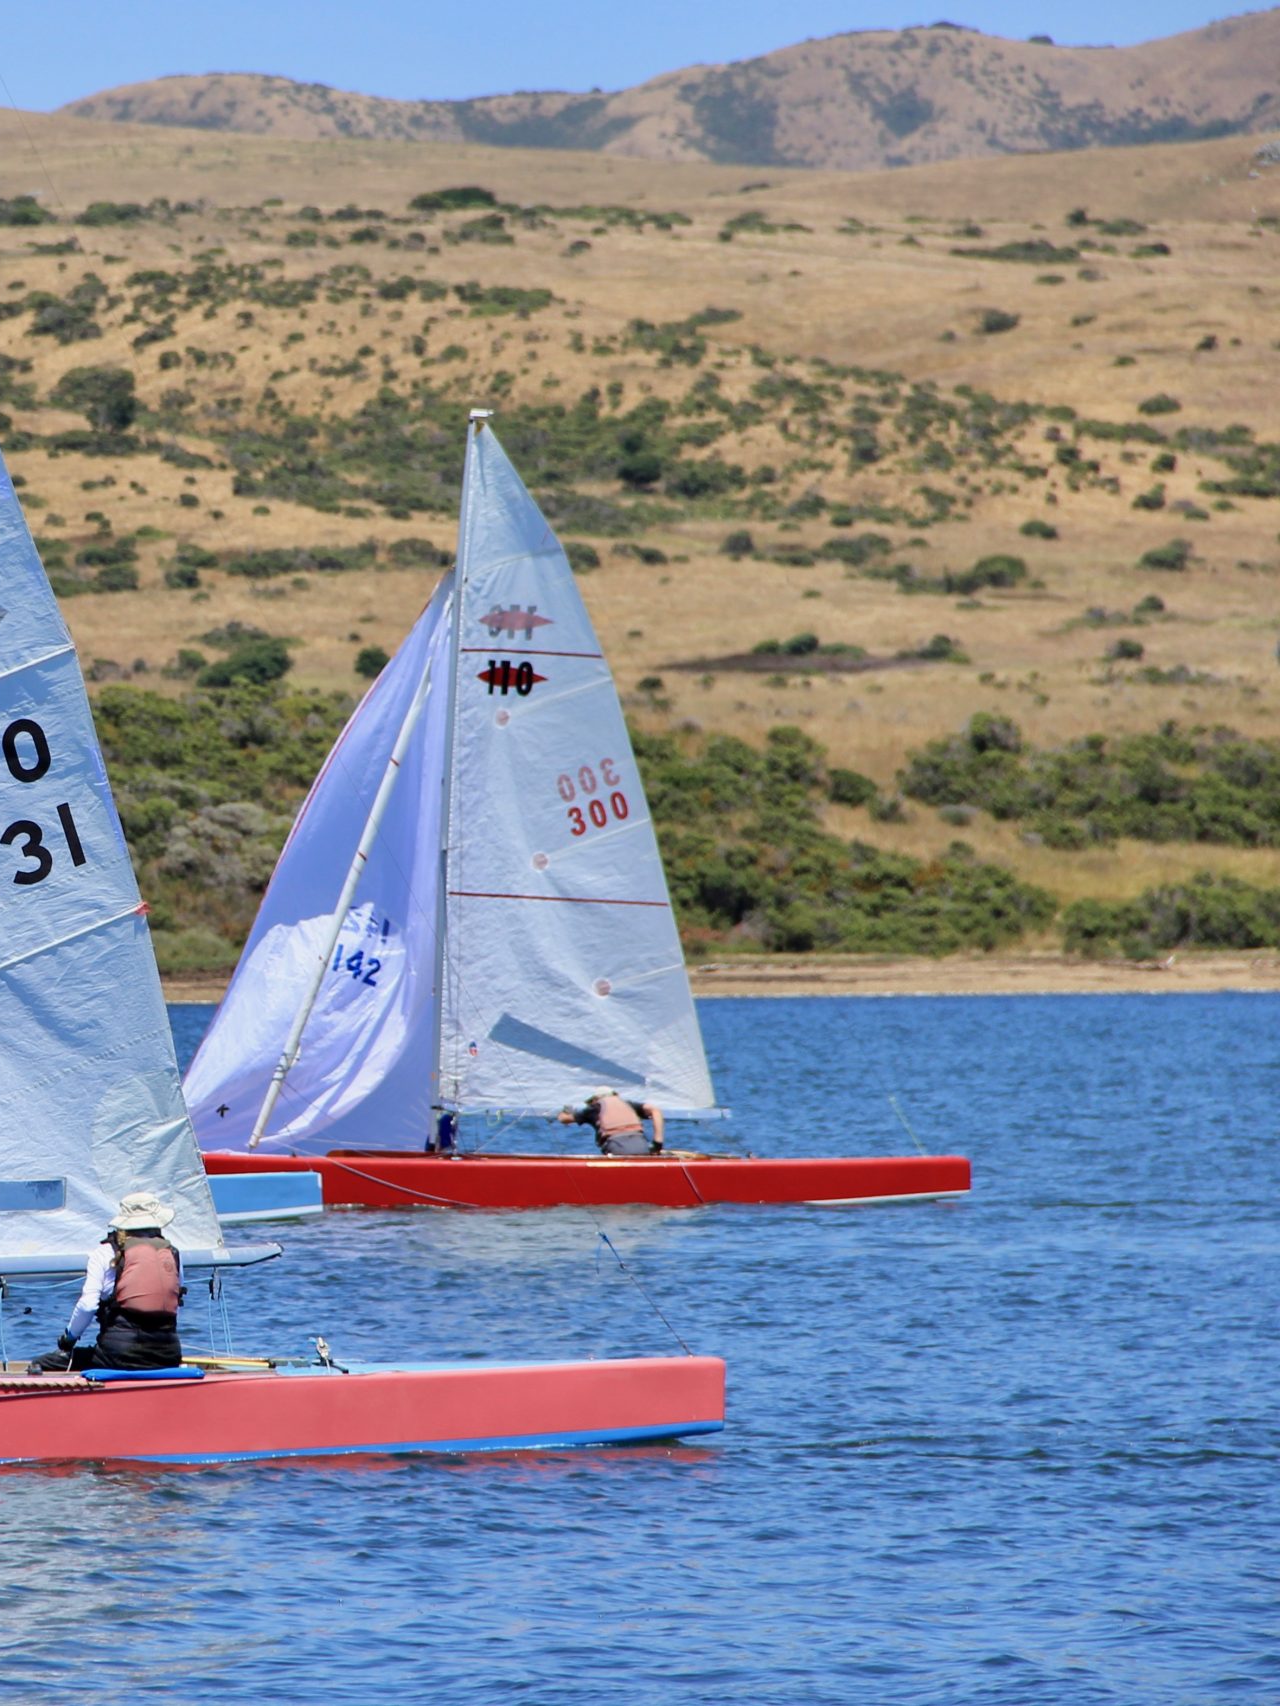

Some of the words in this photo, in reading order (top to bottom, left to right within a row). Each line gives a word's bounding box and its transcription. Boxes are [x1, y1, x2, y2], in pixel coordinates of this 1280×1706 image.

[488, 660, 533, 696] 110
[567, 791, 628, 836] 300
[332, 944, 381, 987] 142
